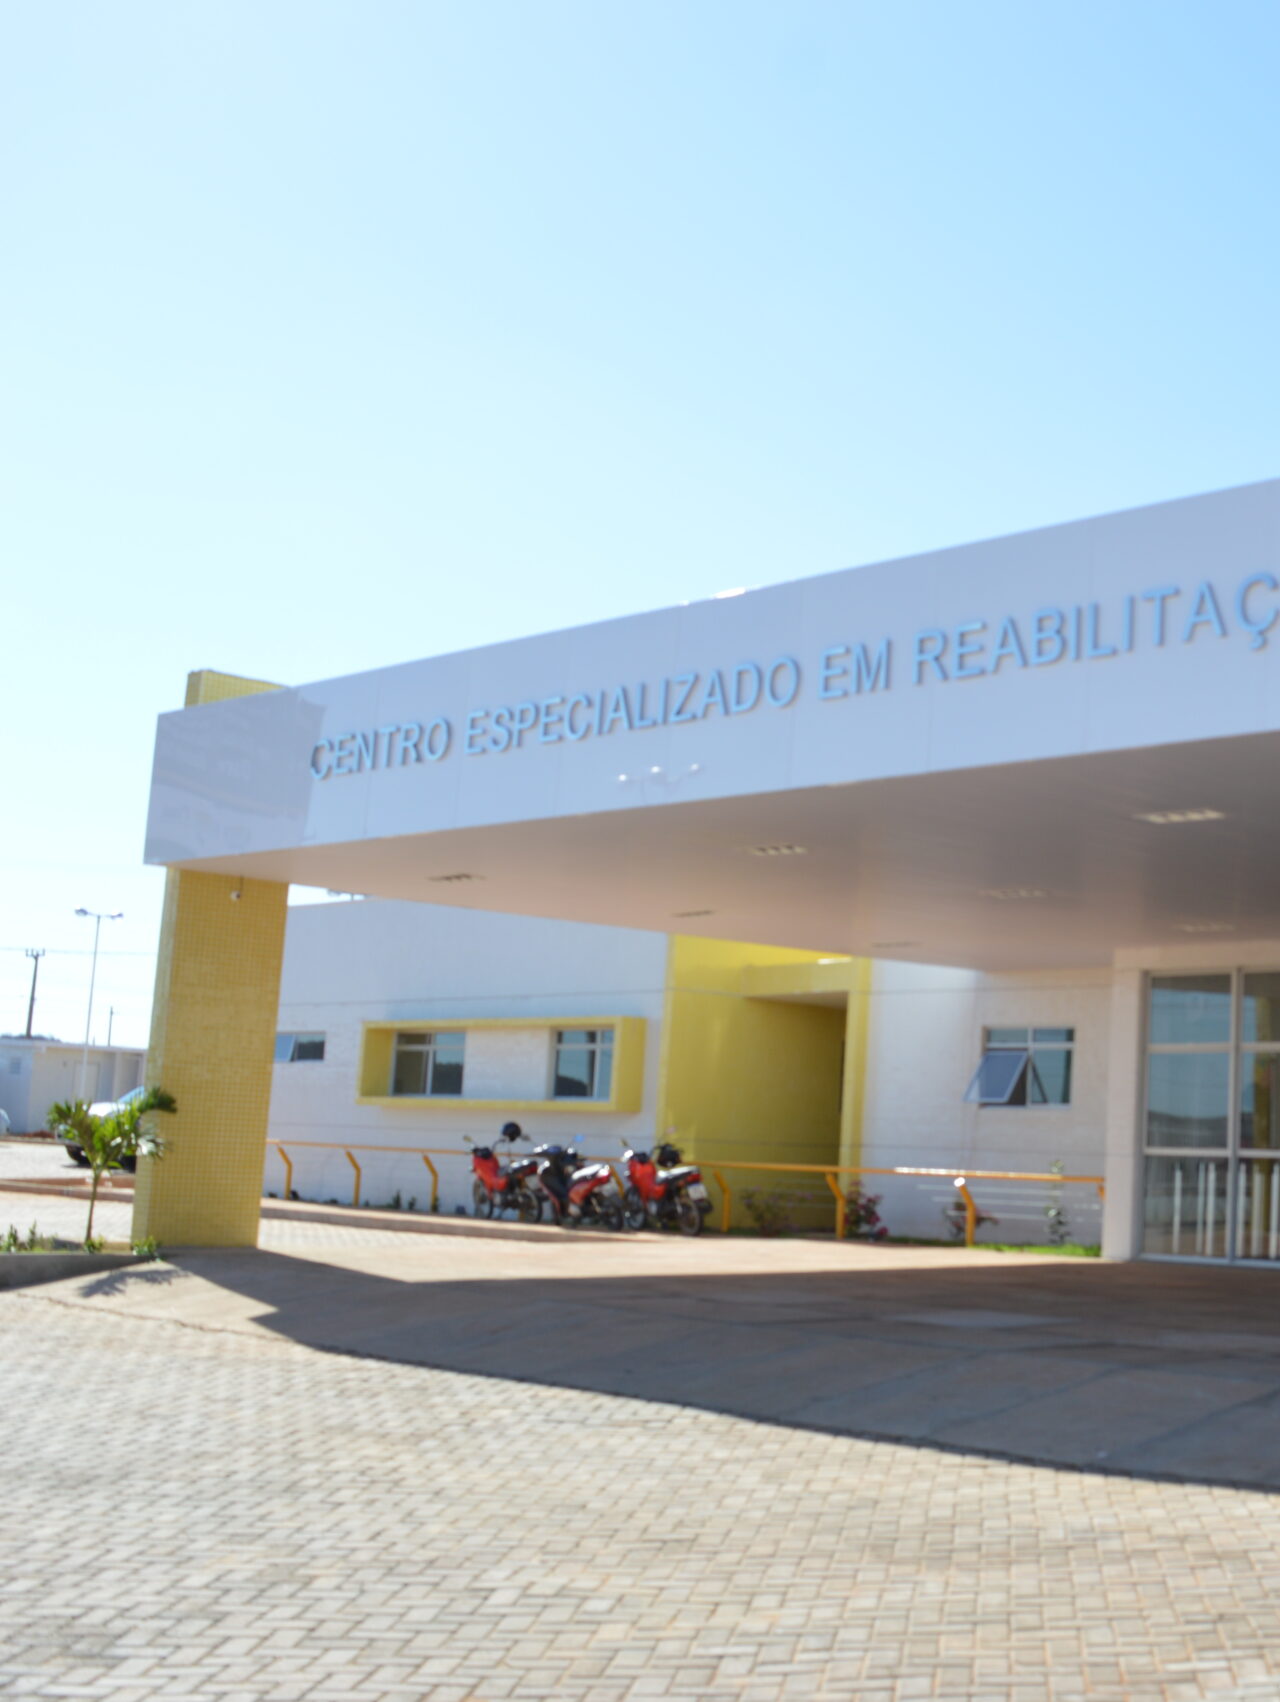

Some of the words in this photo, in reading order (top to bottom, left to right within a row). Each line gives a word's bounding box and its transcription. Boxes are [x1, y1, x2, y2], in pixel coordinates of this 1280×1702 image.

[310, 715, 453, 781] CENTRO
[464, 654, 800, 757] ESPECIALIZADO
[817, 636, 892, 701] EM
